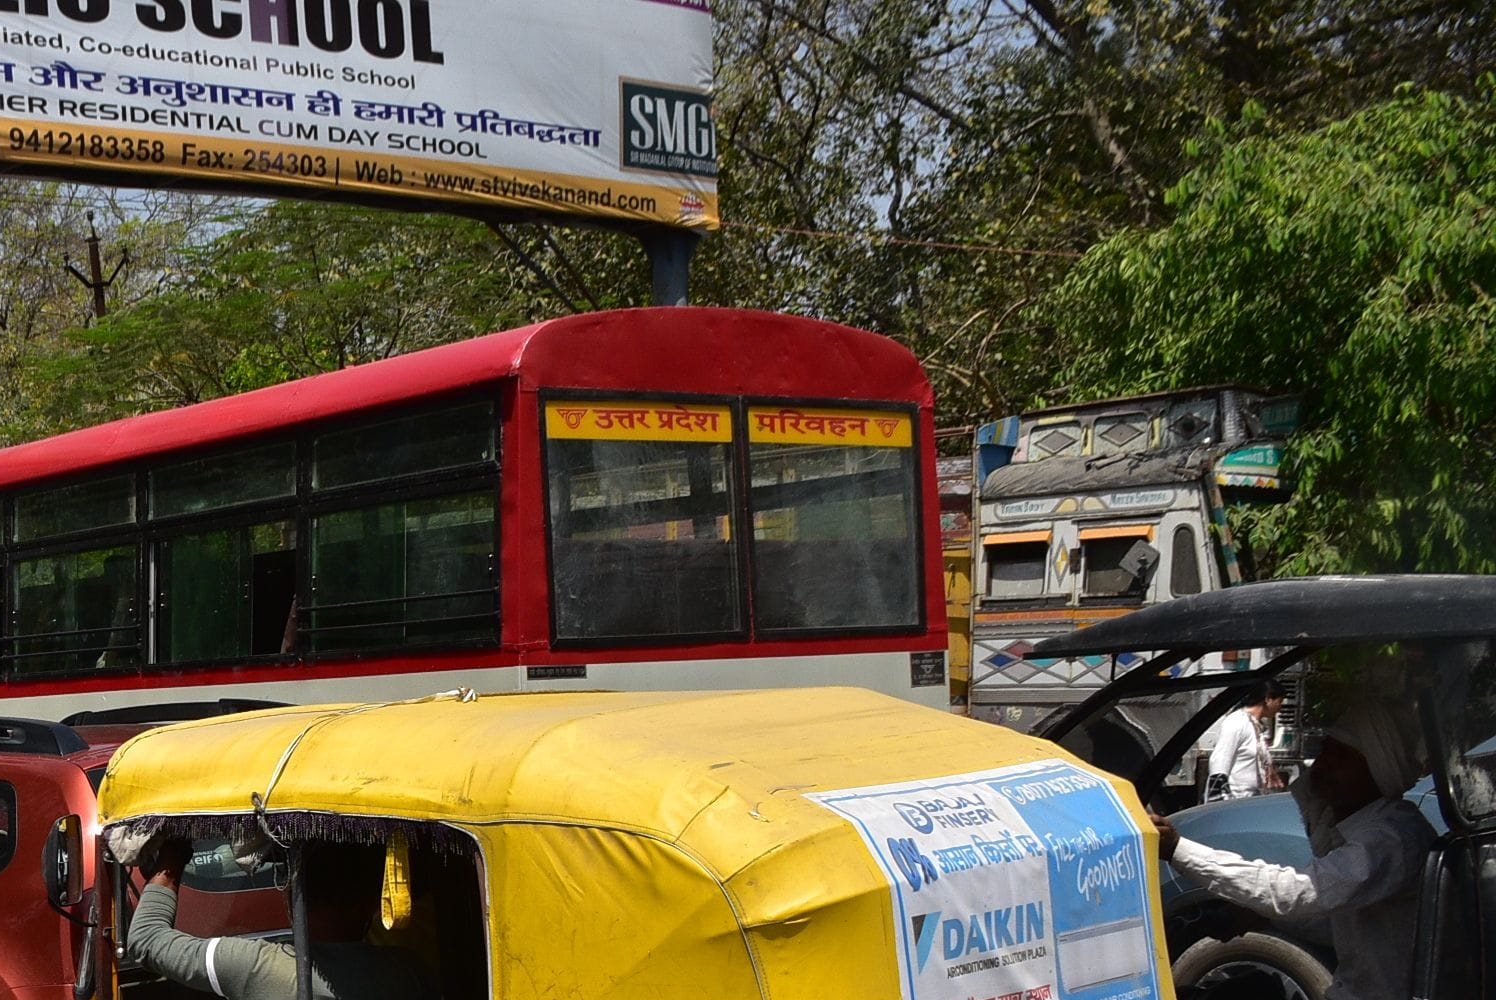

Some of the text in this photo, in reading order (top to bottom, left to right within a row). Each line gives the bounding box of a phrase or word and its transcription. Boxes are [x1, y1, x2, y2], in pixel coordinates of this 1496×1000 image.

[79, 36, 257, 71] Co-educational
[266, 57, 334, 80] Public
[342, 67, 416, 90] School
[29, 61, 106, 92] और
[116, 75, 296, 112] अनुशासन
[305, 90, 343, 117] ही
[351, 102, 446, 128] हमारी
[454, 109, 602, 148] प्रतिबद्धता
[58, 99, 251, 134] RESIDENTIAL
[258, 119, 318, 141] CUM
[328, 126, 379, 146] DAY
[387, 133, 488, 159] SCHOOL
[8, 126, 165, 163] 9412183358
[181, 142, 234, 170] Fax:
[241, 149, 327, 178] 254303
[355, 160, 403, 185] Web
[424, 172, 657, 213] www.stvivekanand.com
[594, 407, 870, 438] उत्तर प्रदेश परिवहन
[918, 793, 985, 812] BAJAJ
[194, 855, 213, 865] elf
[933, 846, 980, 874] आसान
[971, 829, 1020, 866] किस्तों
[1016, 834, 1043, 857] पर
[1078, 844, 1135, 901] GOODNESS
[942, 901, 1044, 960] DAIKIN
[947, 946, 1047, 979] AIRCONDITIONING SOLUTION PLAZA
